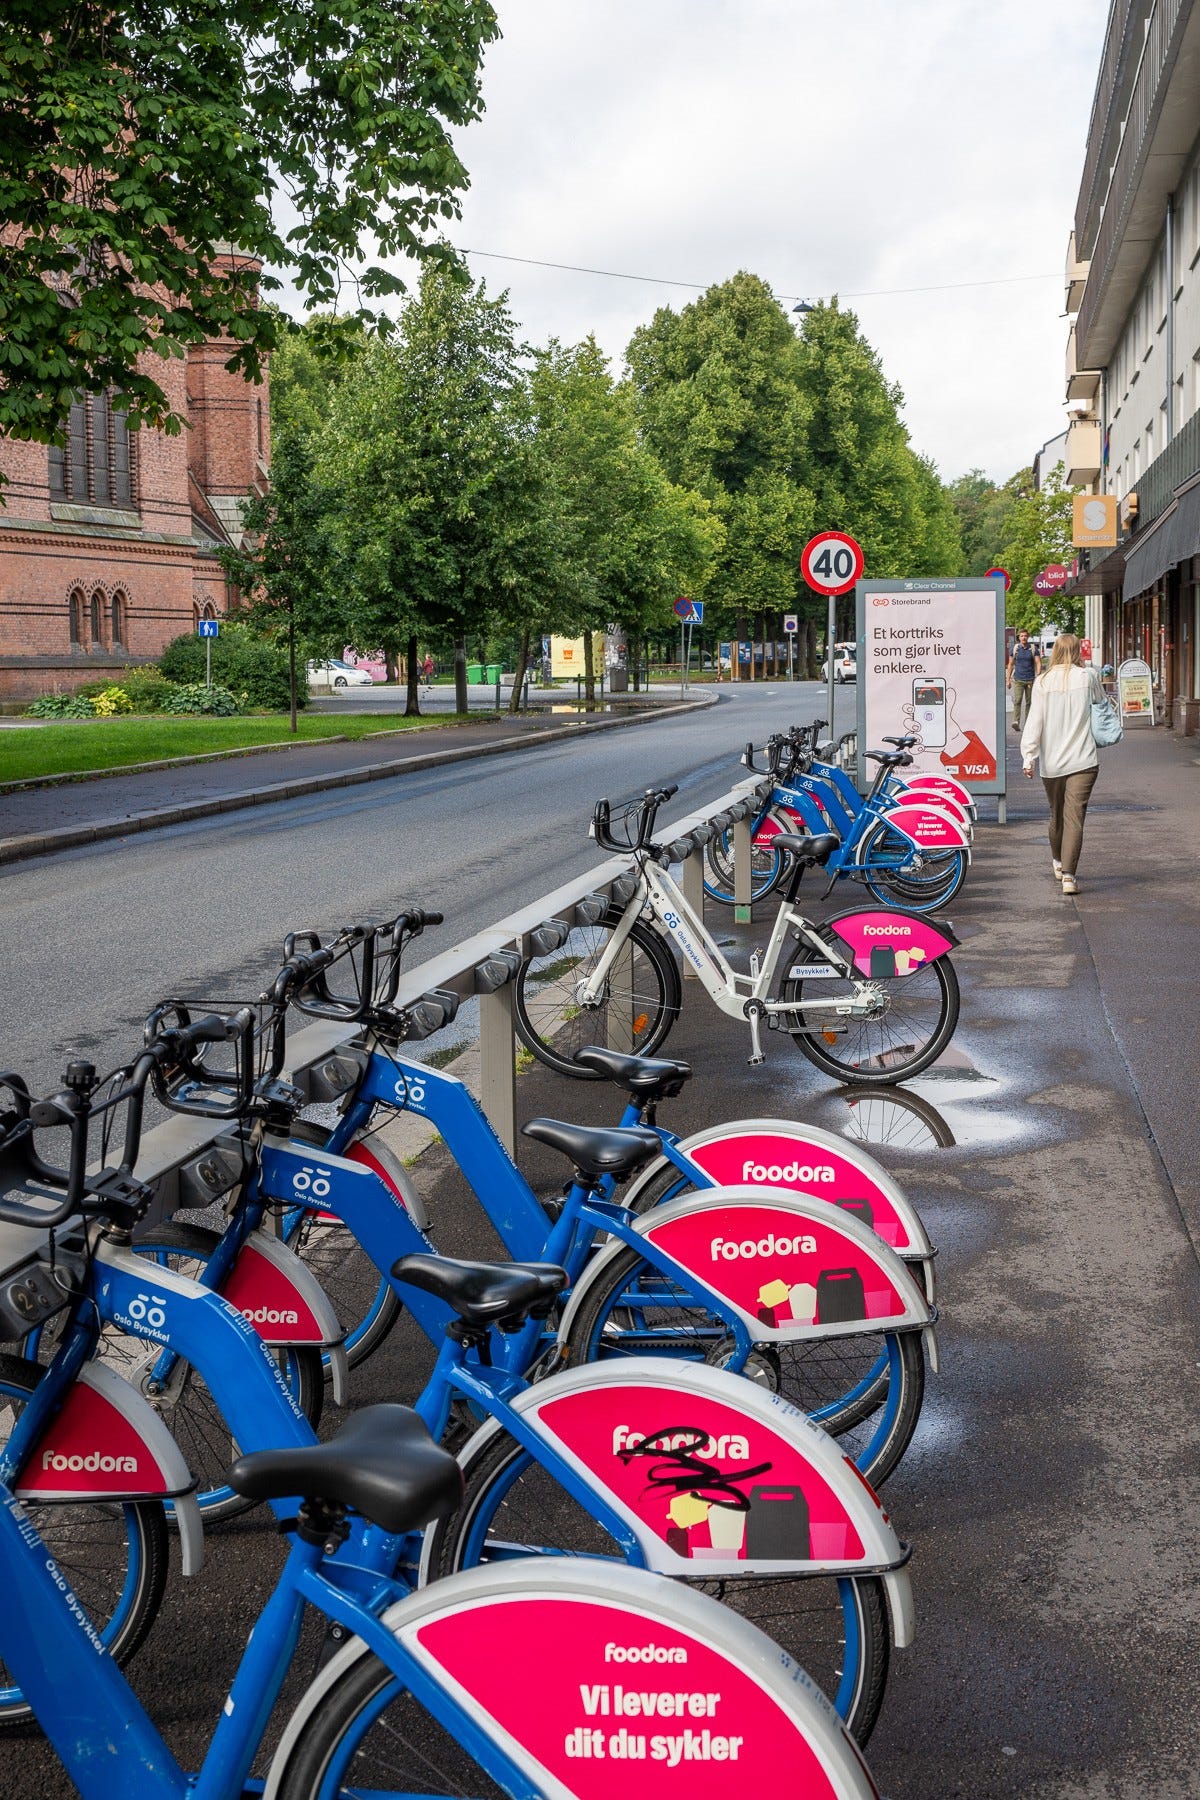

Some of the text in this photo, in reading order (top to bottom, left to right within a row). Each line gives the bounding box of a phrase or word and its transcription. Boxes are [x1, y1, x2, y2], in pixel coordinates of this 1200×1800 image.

[813, 548, 853, 578] 40
[873, 627, 944, 639] Et korttriks
[873, 644, 962, 659] som gjør livet
[873, 662, 927, 674] enklere.
[963, 764, 990, 775] VISA
[863, 925, 912, 936] foodora
[677, 931, 704, 969] Oslo Bysykkel
[796, 968, 826, 976] Bysykkel
[742, 1161, 835, 1183] foodora
[294, 1191, 307, 1201] Oslo
[711, 1233, 818, 1261] foodora
[18, 1292, 33, 1310] 2
[242, 1306, 298, 1324] odora
[113, 1312, 171, 1343] Oslo Bysykkel
[259, 1342, 305, 1420] Oslo Bysykkel
[41, 1450, 138, 1473] foodora
[45, 1559, 107, 1656] Oslo Bysykkel
[604, 1642, 688, 1664] foodora
[579, 1685, 721, 1718] Vi leverer
[564, 1728, 743, 1767] dit du sykler
